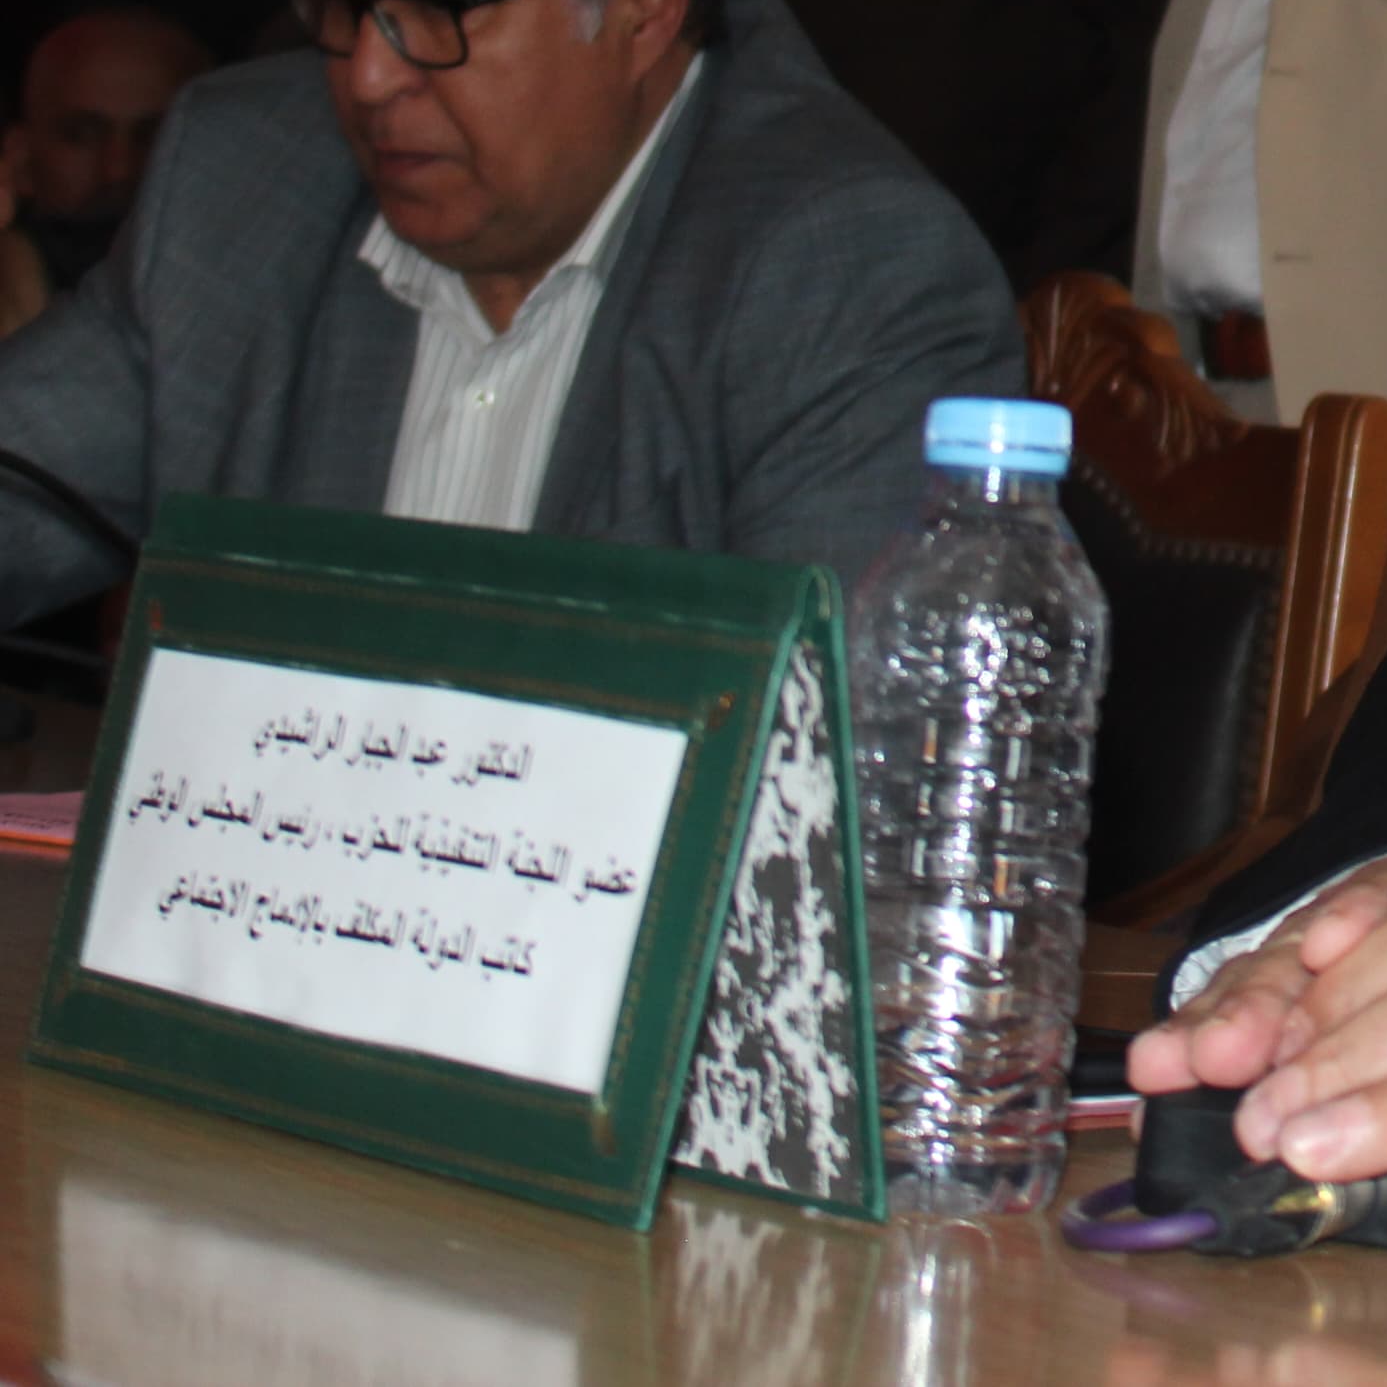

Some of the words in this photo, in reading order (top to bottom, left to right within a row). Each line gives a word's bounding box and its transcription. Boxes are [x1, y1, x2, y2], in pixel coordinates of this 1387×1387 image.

[344, 720, 409, 769] الجبار
[410, 736, 448, 778] عبد
[452, 742, 532, 787] الدكتور
[127, 769, 190, 826] الوطني
[186, 784, 264, 836] المجلس
[260, 804, 322, 850] رئيس
[413, 810, 499, 876] التنفيذية
[505, 828, 570, 893] اللجنة
[573, 854, 637, 904] عضو
[334, 898, 405, 948] المكلف
[412, 906, 475, 971] الدولة
[480, 933, 538, 984] كاتب
